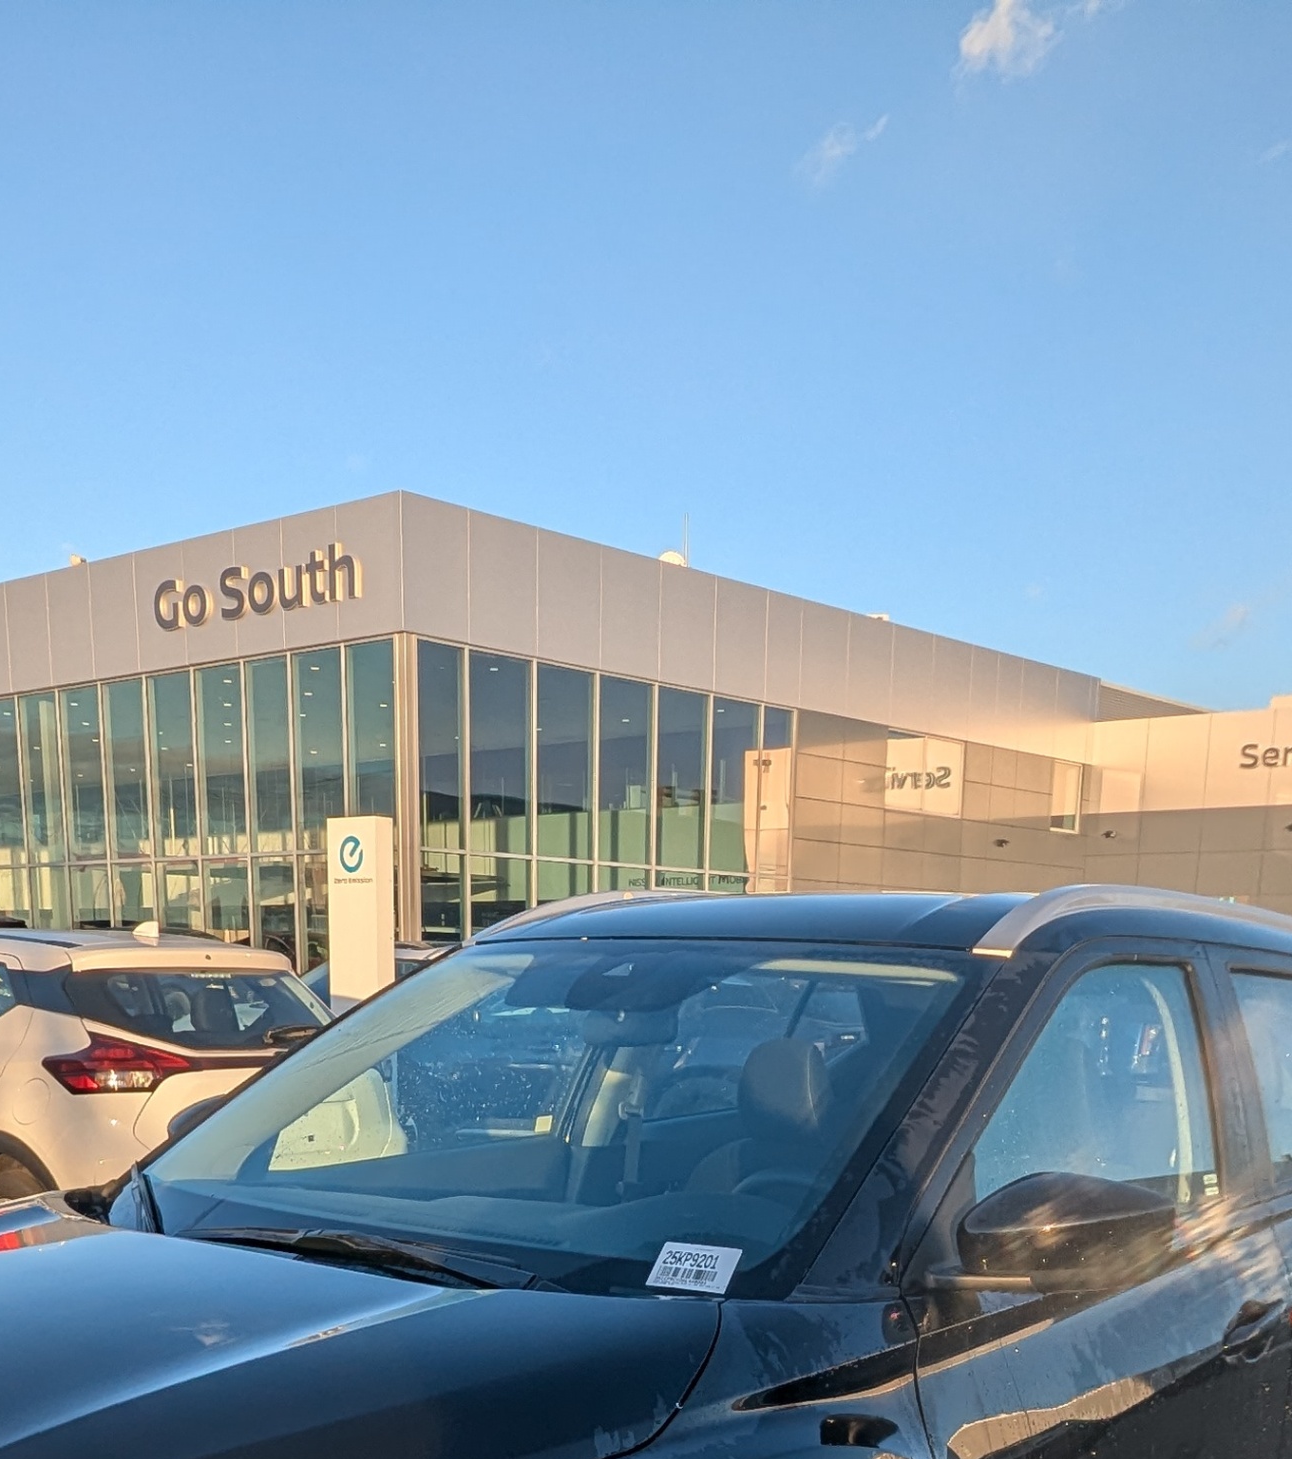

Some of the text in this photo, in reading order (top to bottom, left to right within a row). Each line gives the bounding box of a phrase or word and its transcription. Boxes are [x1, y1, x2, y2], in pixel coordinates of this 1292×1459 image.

[154, 541, 363, 632] Go South
[662, 1250, 720, 1270] 25KP9201
